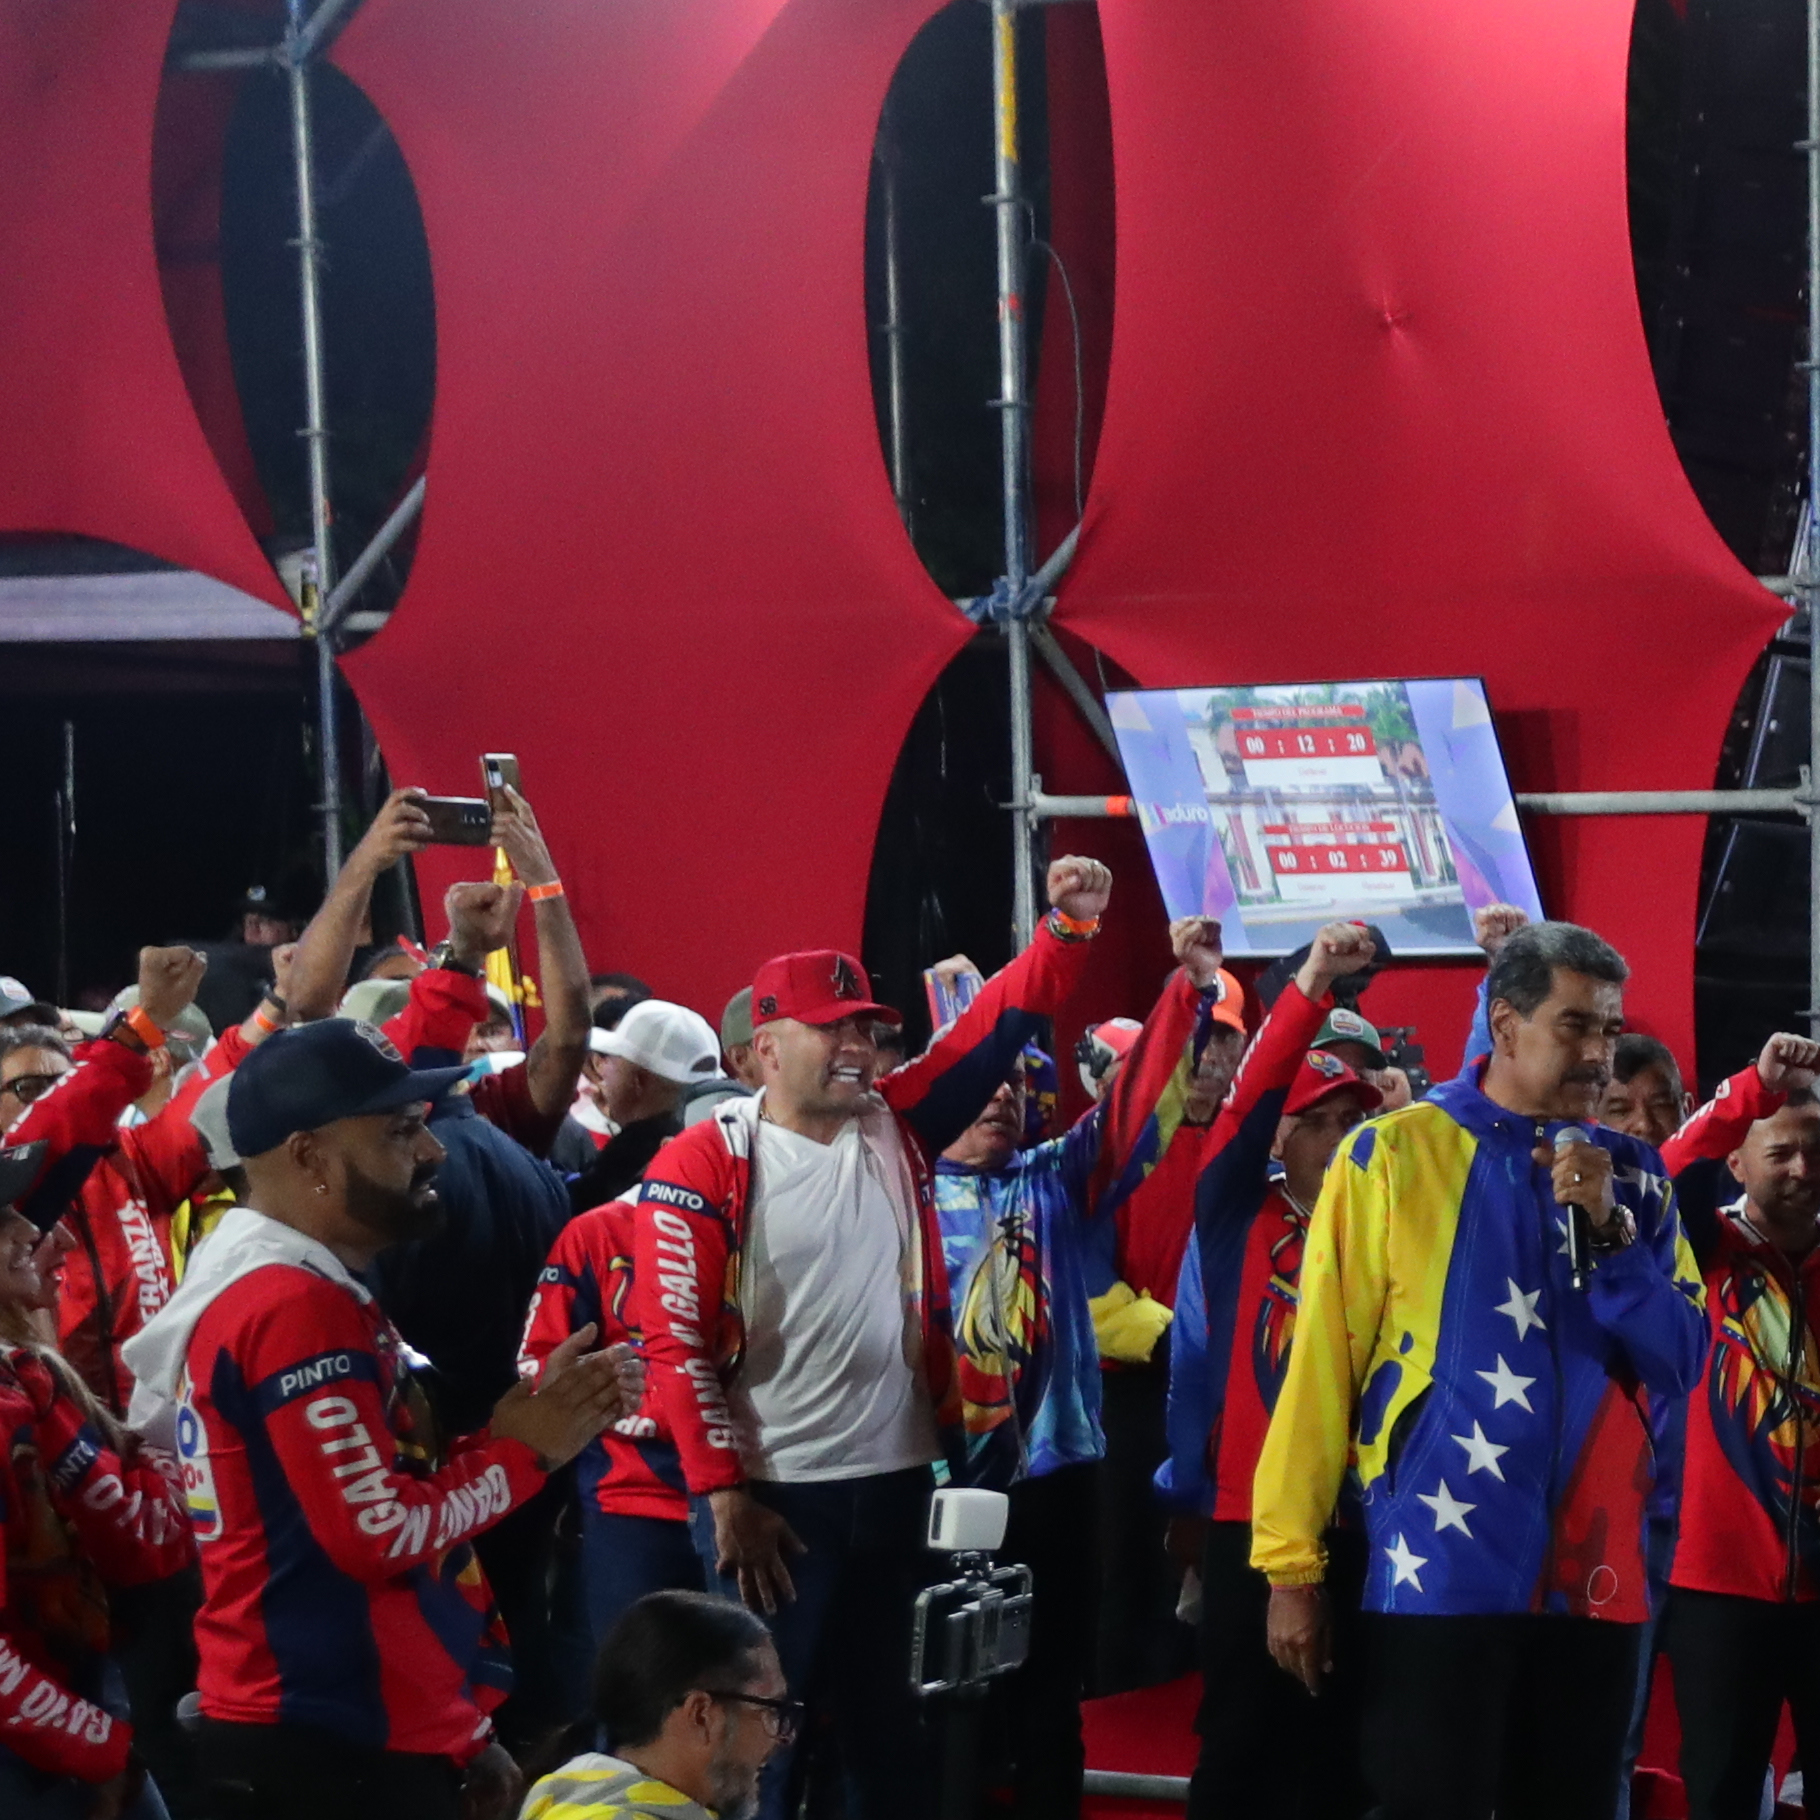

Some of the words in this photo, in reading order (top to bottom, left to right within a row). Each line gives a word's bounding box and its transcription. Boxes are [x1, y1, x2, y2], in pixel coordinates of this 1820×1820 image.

[1246, 737, 1265, 755] 00
[1297, 735, 1316, 753] 12
[1346, 733, 1367, 752] 20
[1278, 852, 1298, 869] 00
[1328, 850, 1348, 868] 02
[1379, 849, 1398, 867] 39
[648, 1183, 704, 1210] PINTO
[653, 1210, 701, 1321] GALLO
[280, 1354, 351, 1397] PINTO
[305, 1396, 408, 1536] GALLO
